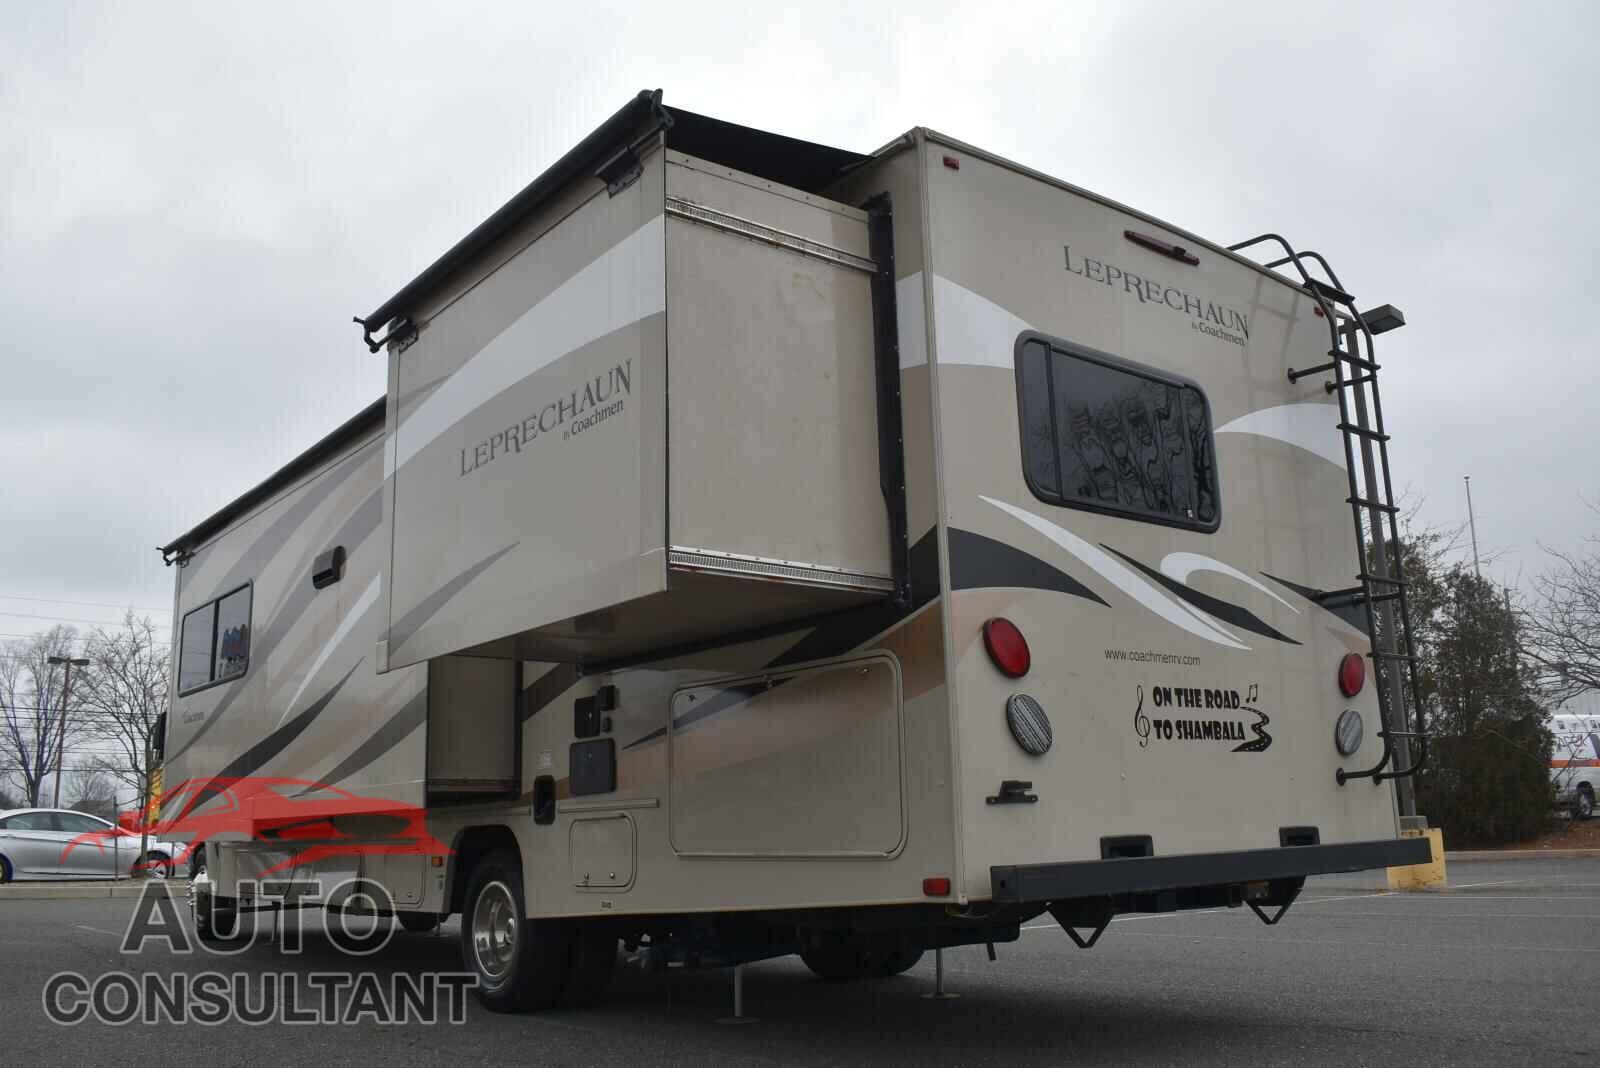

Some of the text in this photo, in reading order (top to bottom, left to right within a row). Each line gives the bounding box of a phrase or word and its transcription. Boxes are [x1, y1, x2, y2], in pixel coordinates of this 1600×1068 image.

[1063, 245, 1249, 340] LEPRECHAUN
[1199, 322, 1246, 347] Coachmen
[460, 358, 632, 477] LEPRECHAUN
[570, 399, 624, 436] Coachmen
[1104, 648, 1201, 666] www.coachmenrv.com
[1153, 686, 1241, 710] ON THE ROAD
[1153, 719, 1246, 741] TO SHAMBALA
